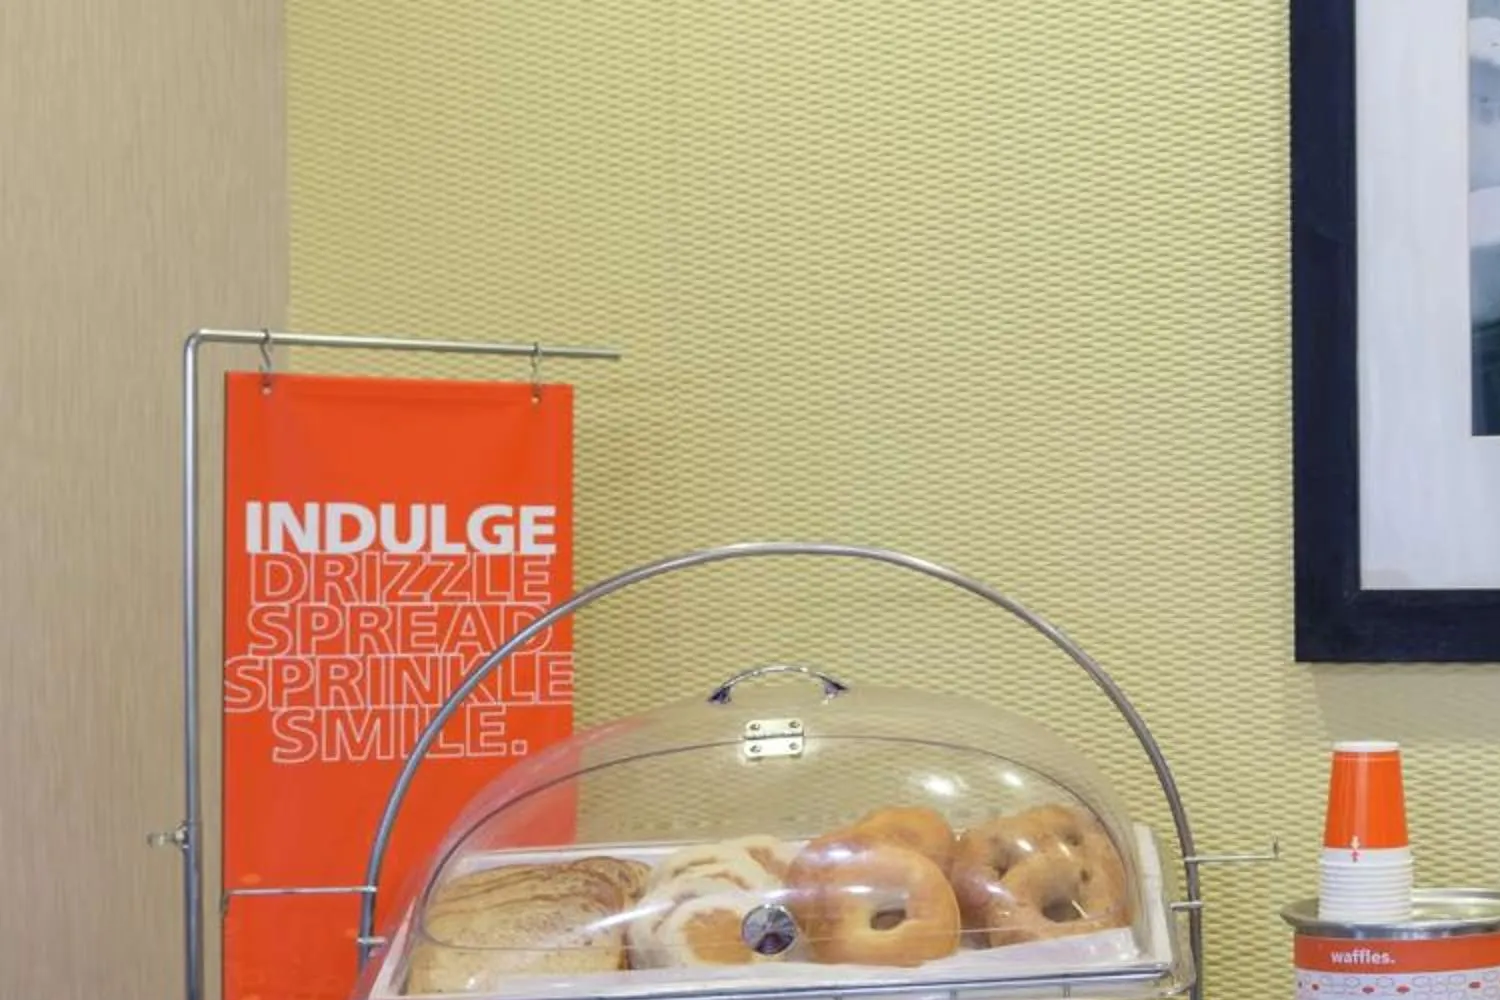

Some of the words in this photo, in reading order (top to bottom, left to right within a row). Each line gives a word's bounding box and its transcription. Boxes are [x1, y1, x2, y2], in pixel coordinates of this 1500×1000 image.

[245, 501, 557, 554] INDULGE
[251, 551, 551, 606] DRIZZLE
[247, 603, 553, 657] SPREAD
[224, 651, 573, 712] SPRINKLE
[272, 703, 529, 763] SMILE.
[1330, 948, 1396, 965] waffles.
